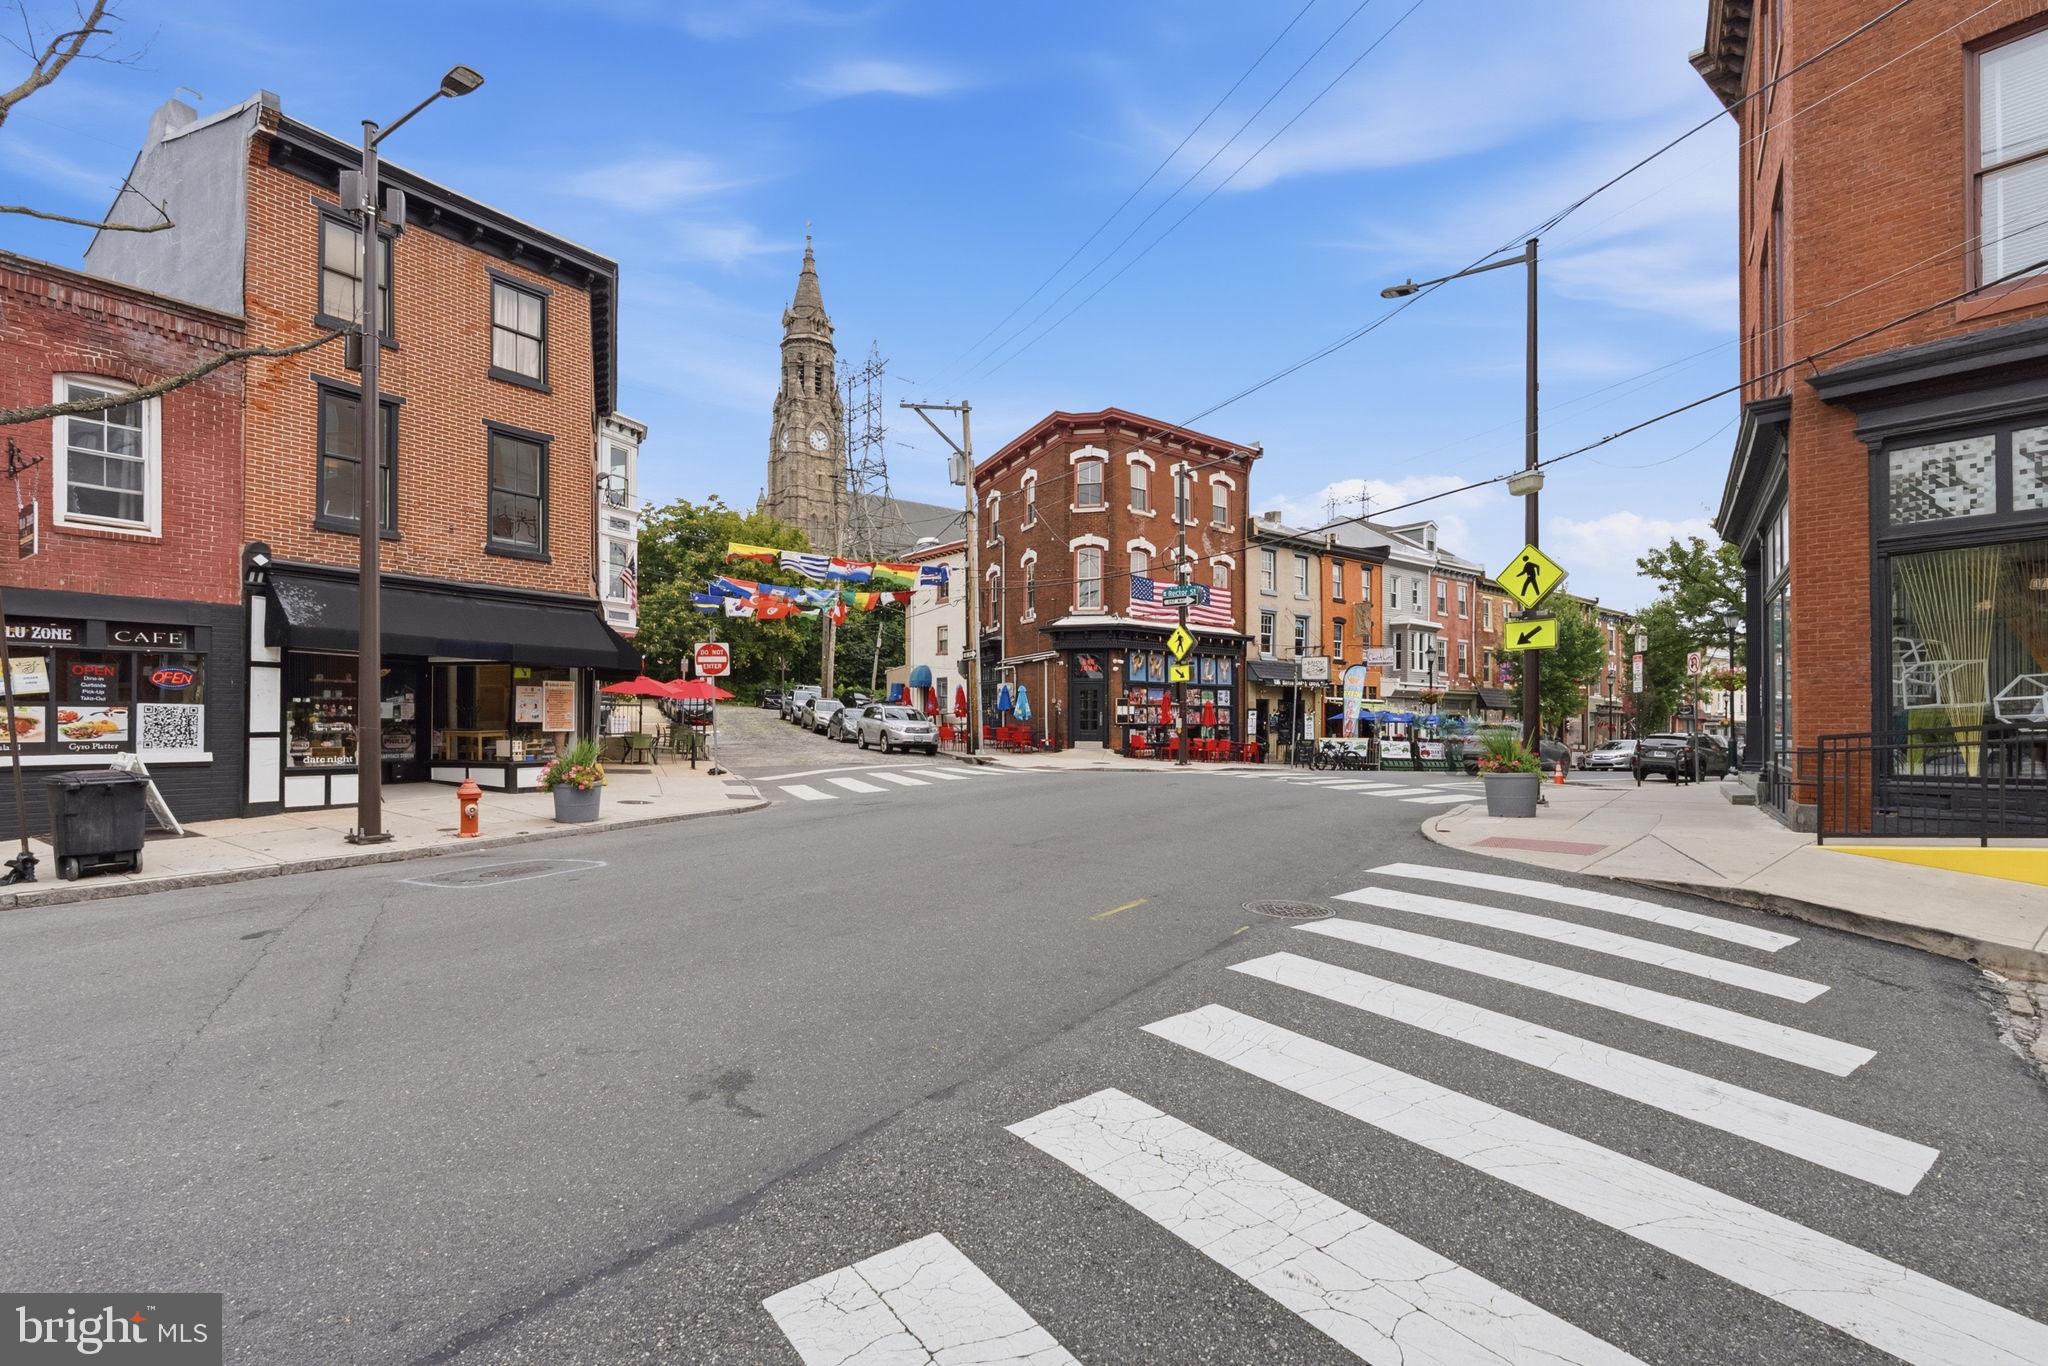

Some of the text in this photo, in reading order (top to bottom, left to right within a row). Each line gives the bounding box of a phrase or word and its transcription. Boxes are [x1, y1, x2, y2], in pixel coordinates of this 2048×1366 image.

[31, 625, 72, 641] ZONE
[114, 630, 183, 645] CAFE
[72, 664, 116, 676] OPEN
[152, 671, 193, 685] OPEN
[68, 743, 90, 752] Gyro
[303, 755, 353, 765] date night
